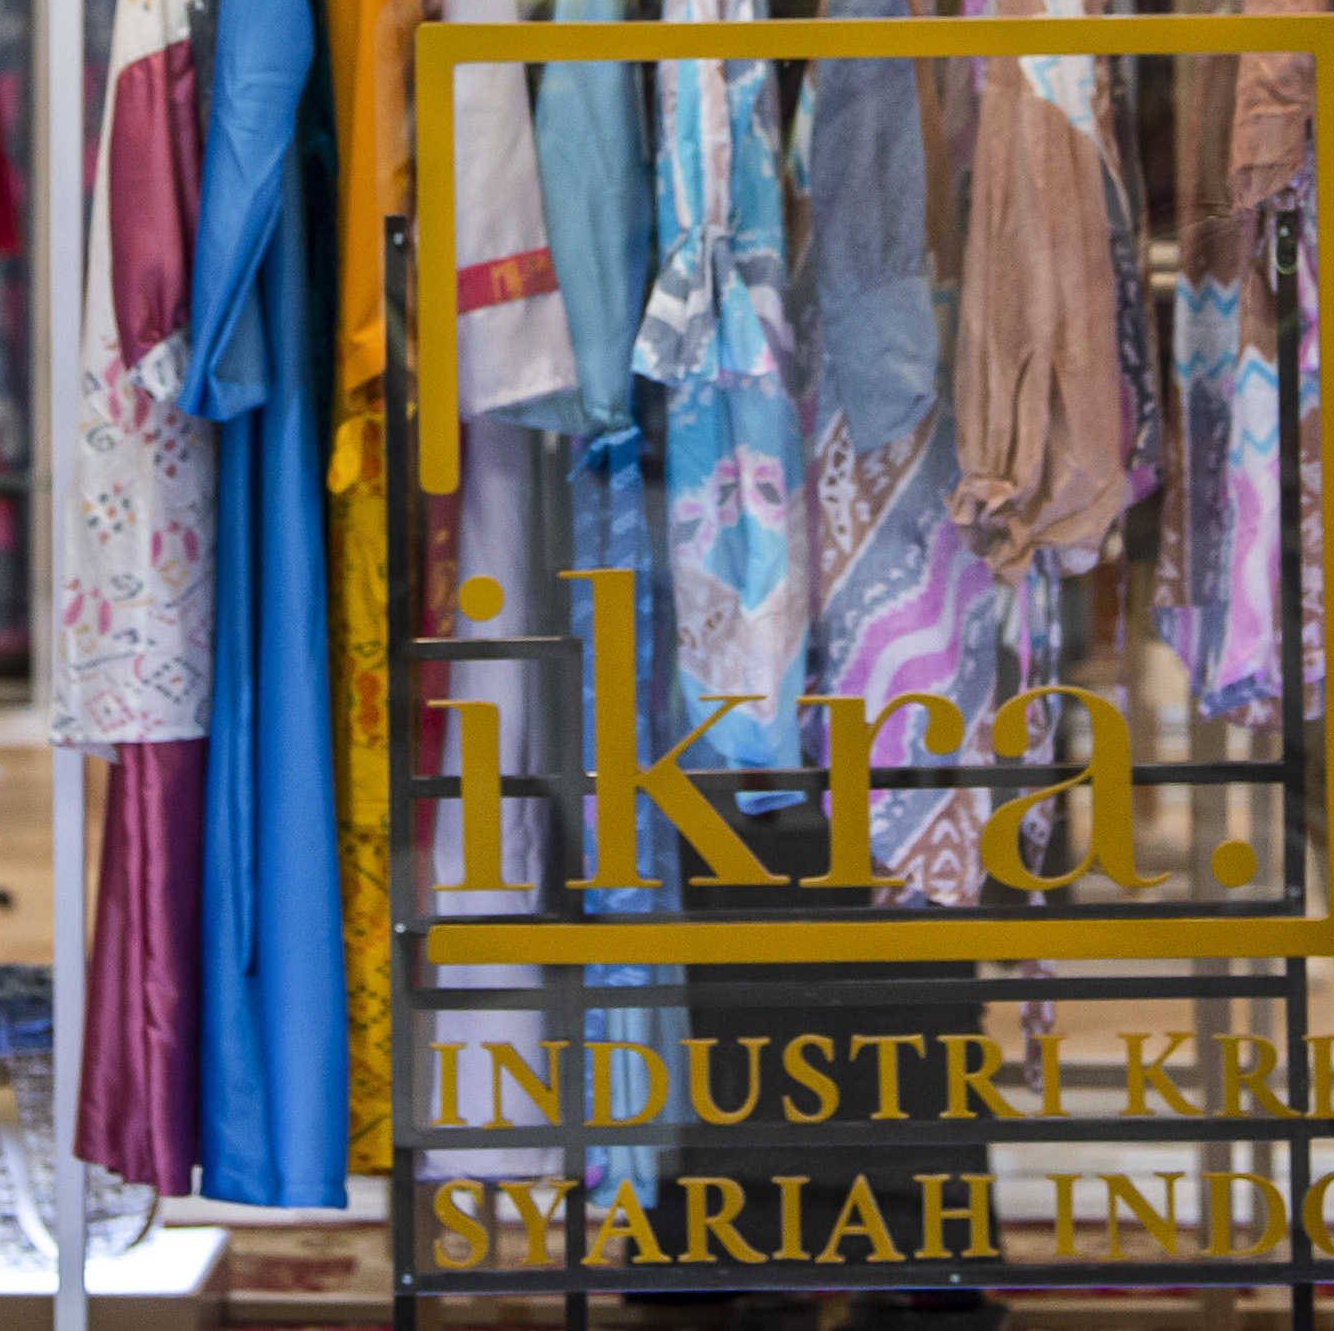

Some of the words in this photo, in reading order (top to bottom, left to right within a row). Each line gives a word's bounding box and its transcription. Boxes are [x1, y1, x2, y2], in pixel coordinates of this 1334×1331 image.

[426, 568, 1259, 892] ikra.
[431, 1033, 1067, 1128] INDUSTRI
[433, 1176, 999, 1268] SYARIAH
